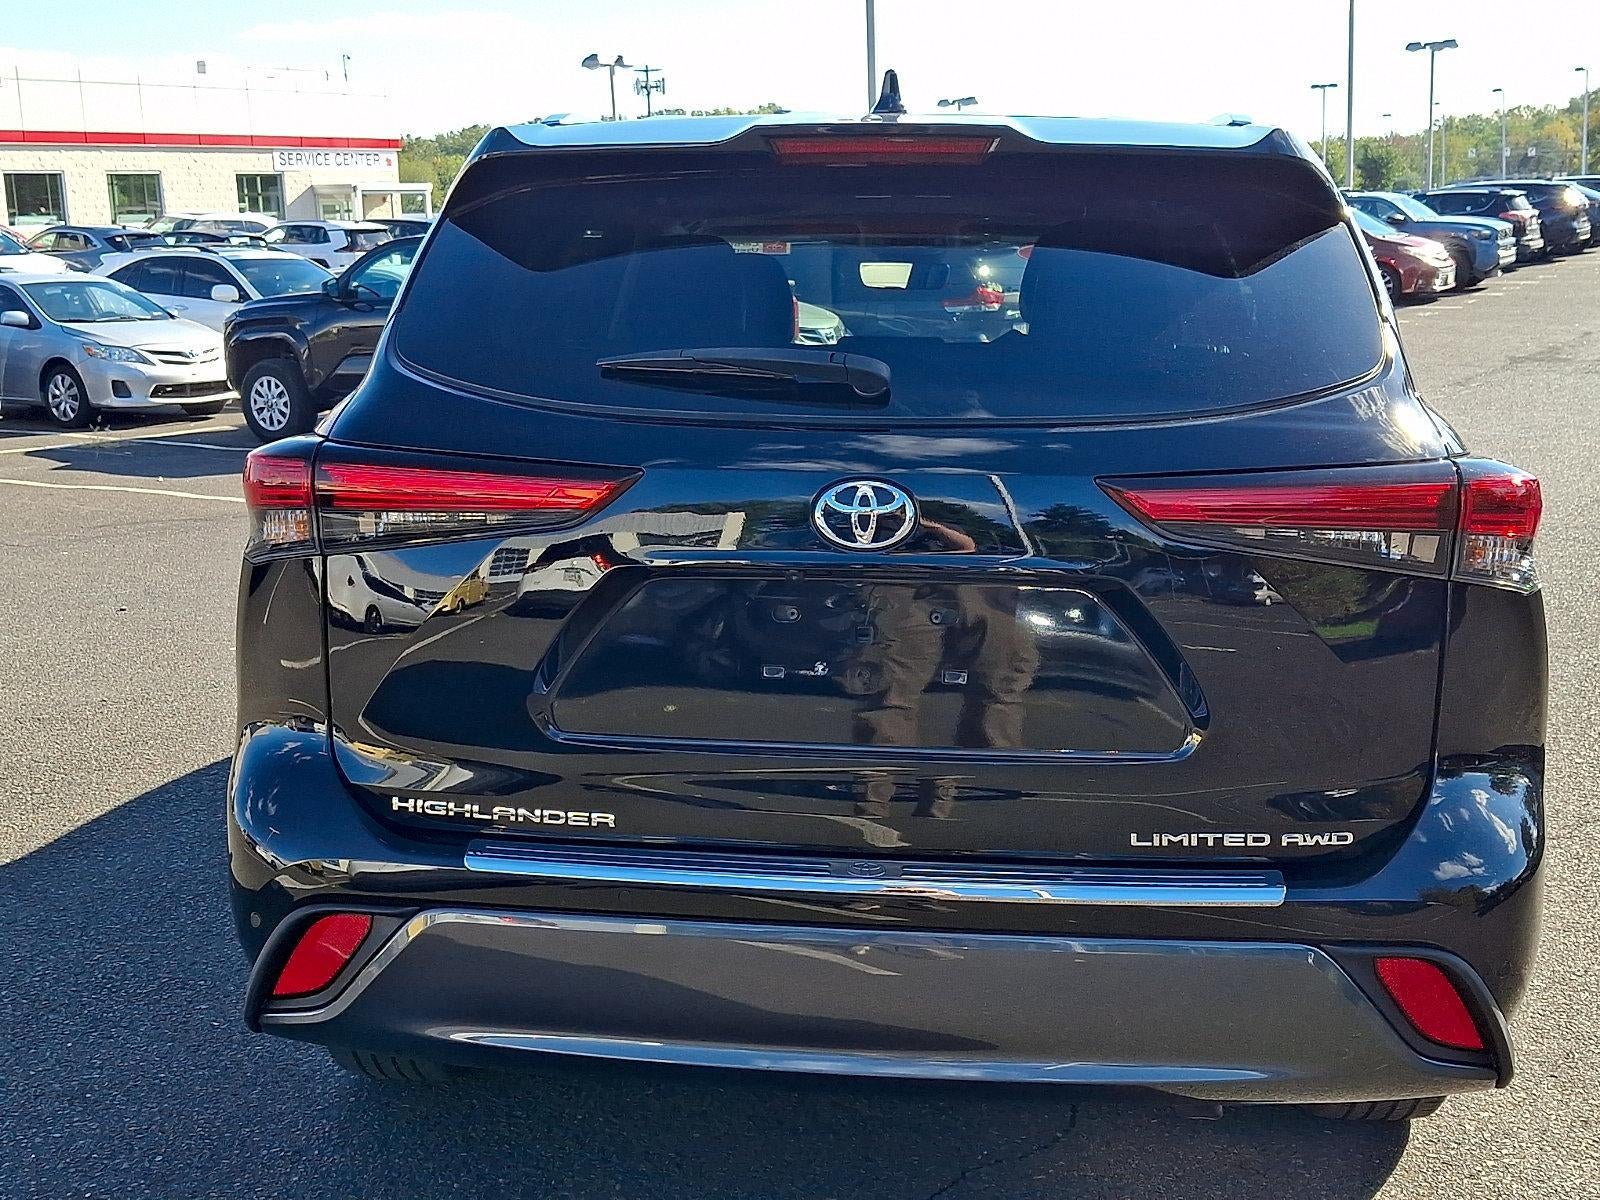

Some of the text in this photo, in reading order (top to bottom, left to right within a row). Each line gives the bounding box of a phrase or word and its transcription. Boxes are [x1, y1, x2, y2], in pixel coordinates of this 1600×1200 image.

[279, 152, 381, 167] SERVICE CENTER
[391, 796, 616, 828] HIGHLANDER
[1130, 831, 1355, 847] LIMITED AWD
